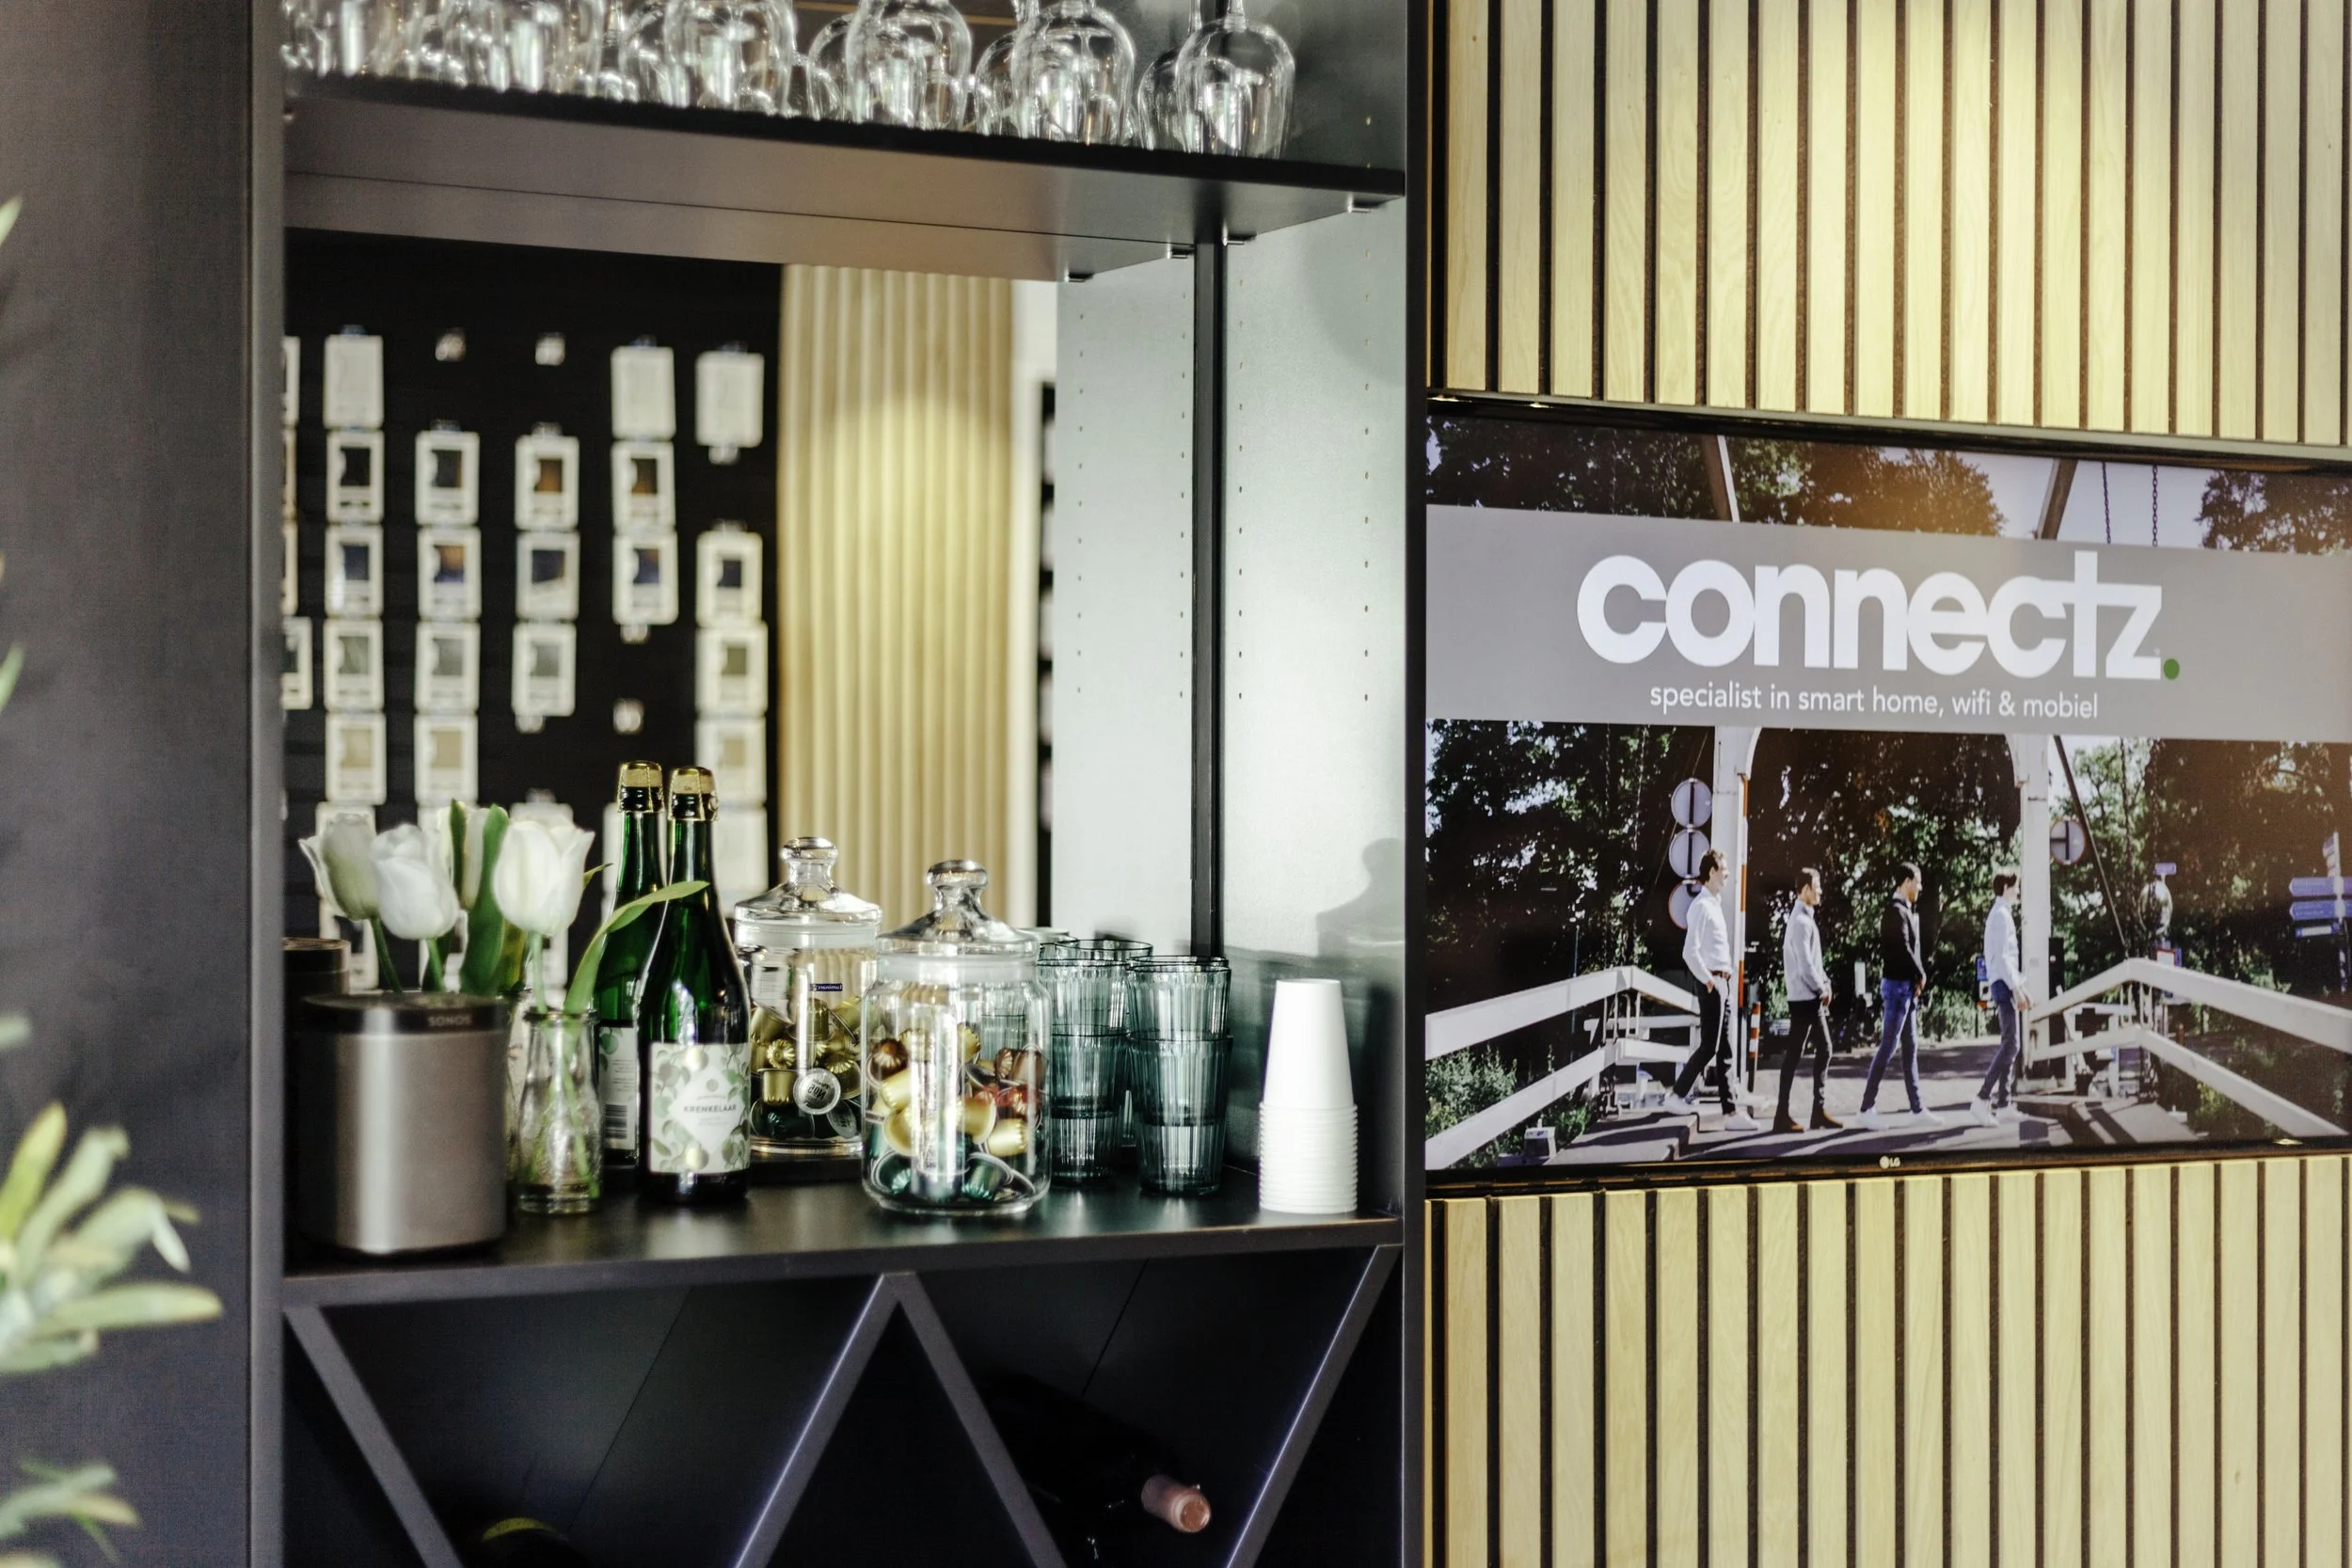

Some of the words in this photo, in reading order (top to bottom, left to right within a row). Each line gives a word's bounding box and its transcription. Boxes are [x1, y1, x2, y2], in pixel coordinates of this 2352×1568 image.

[1577, 549, 2181, 681] connectz.
[1650, 681, 1762, 716] specialist
[1770, 684, 1790, 710] in
[1798, 689, 1865, 712] smart
[1872, 685, 1944, 719] home,
[1951, 688, 1991, 716] wifi
[1998, 690, 2016, 717] &
[2023, 691, 2098, 719] mobiel
[427, 1015, 472, 1027] SONOS
[683, 1103, 738, 1114] KRENKELAAR
